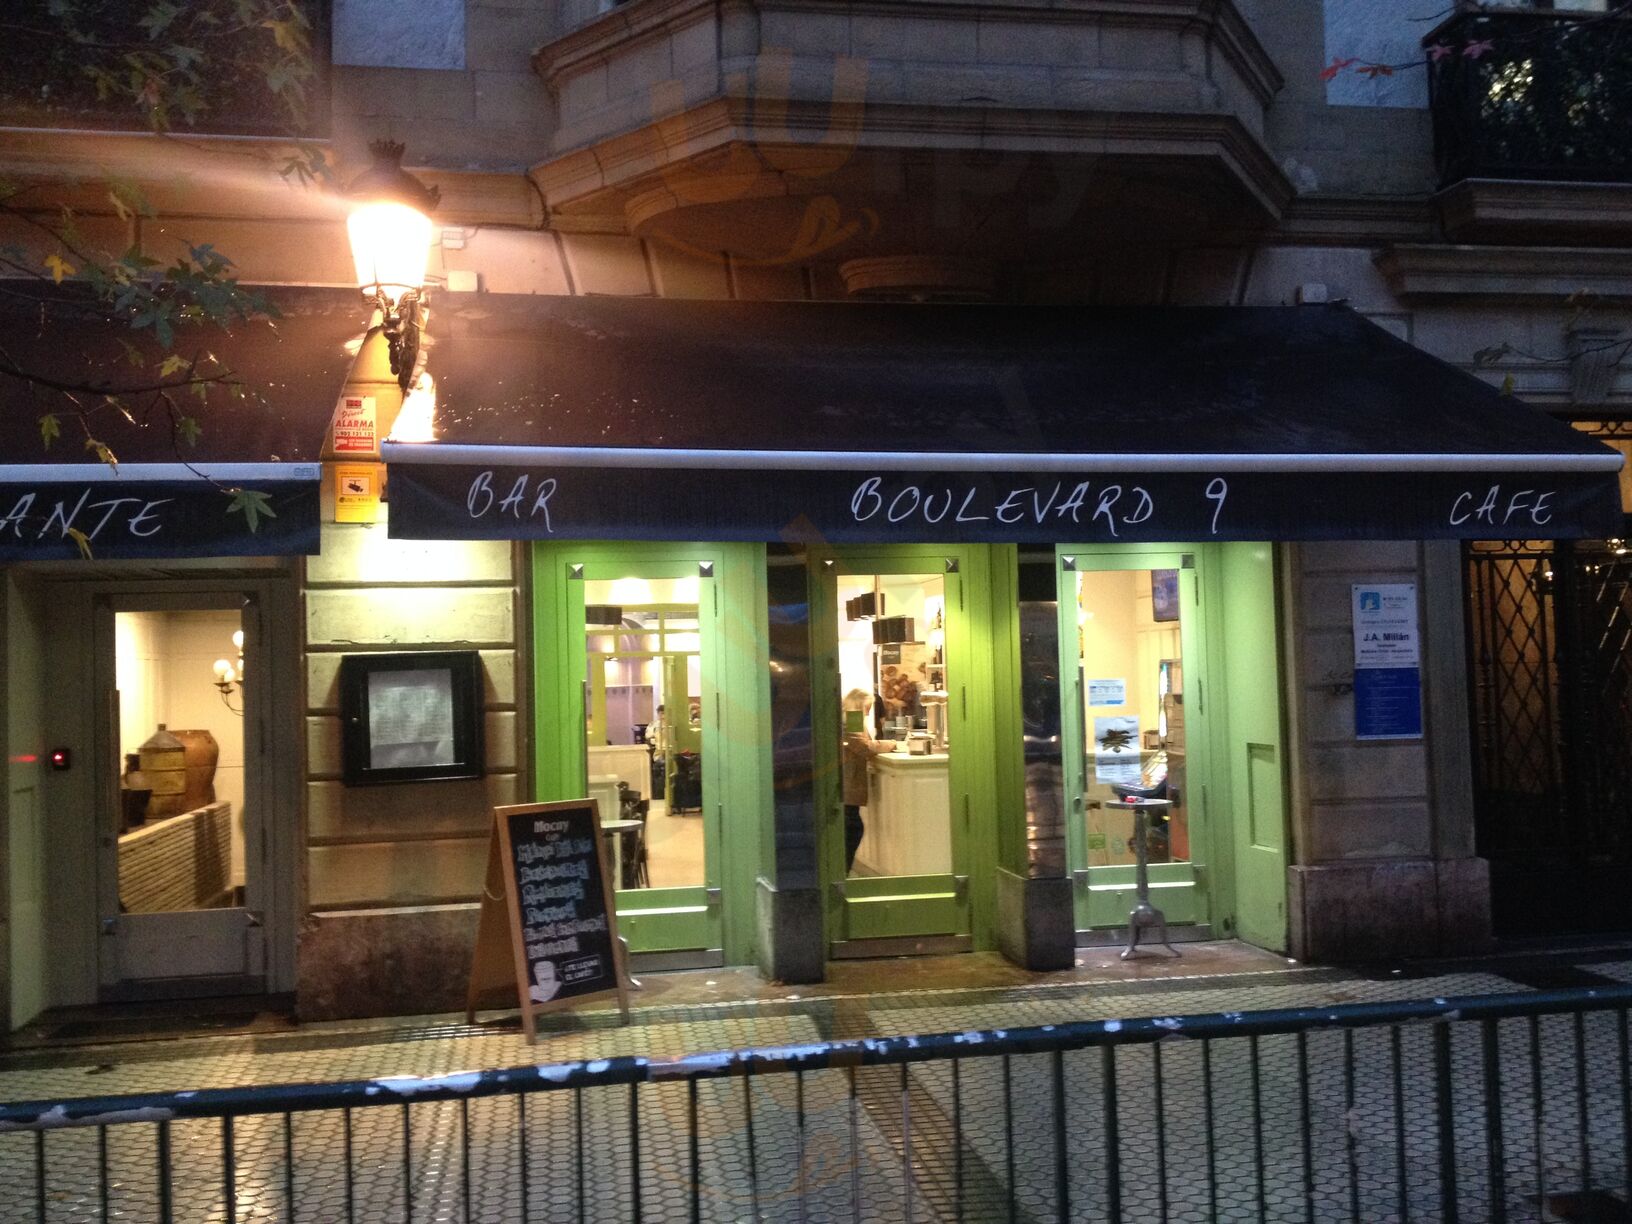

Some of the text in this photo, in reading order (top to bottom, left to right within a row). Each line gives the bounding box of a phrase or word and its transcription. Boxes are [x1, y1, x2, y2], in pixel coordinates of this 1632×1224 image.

[0, 487, 175, 541] ANTE
[467, 471, 1557, 537] BAR BOULEVARD 9 CAFE
